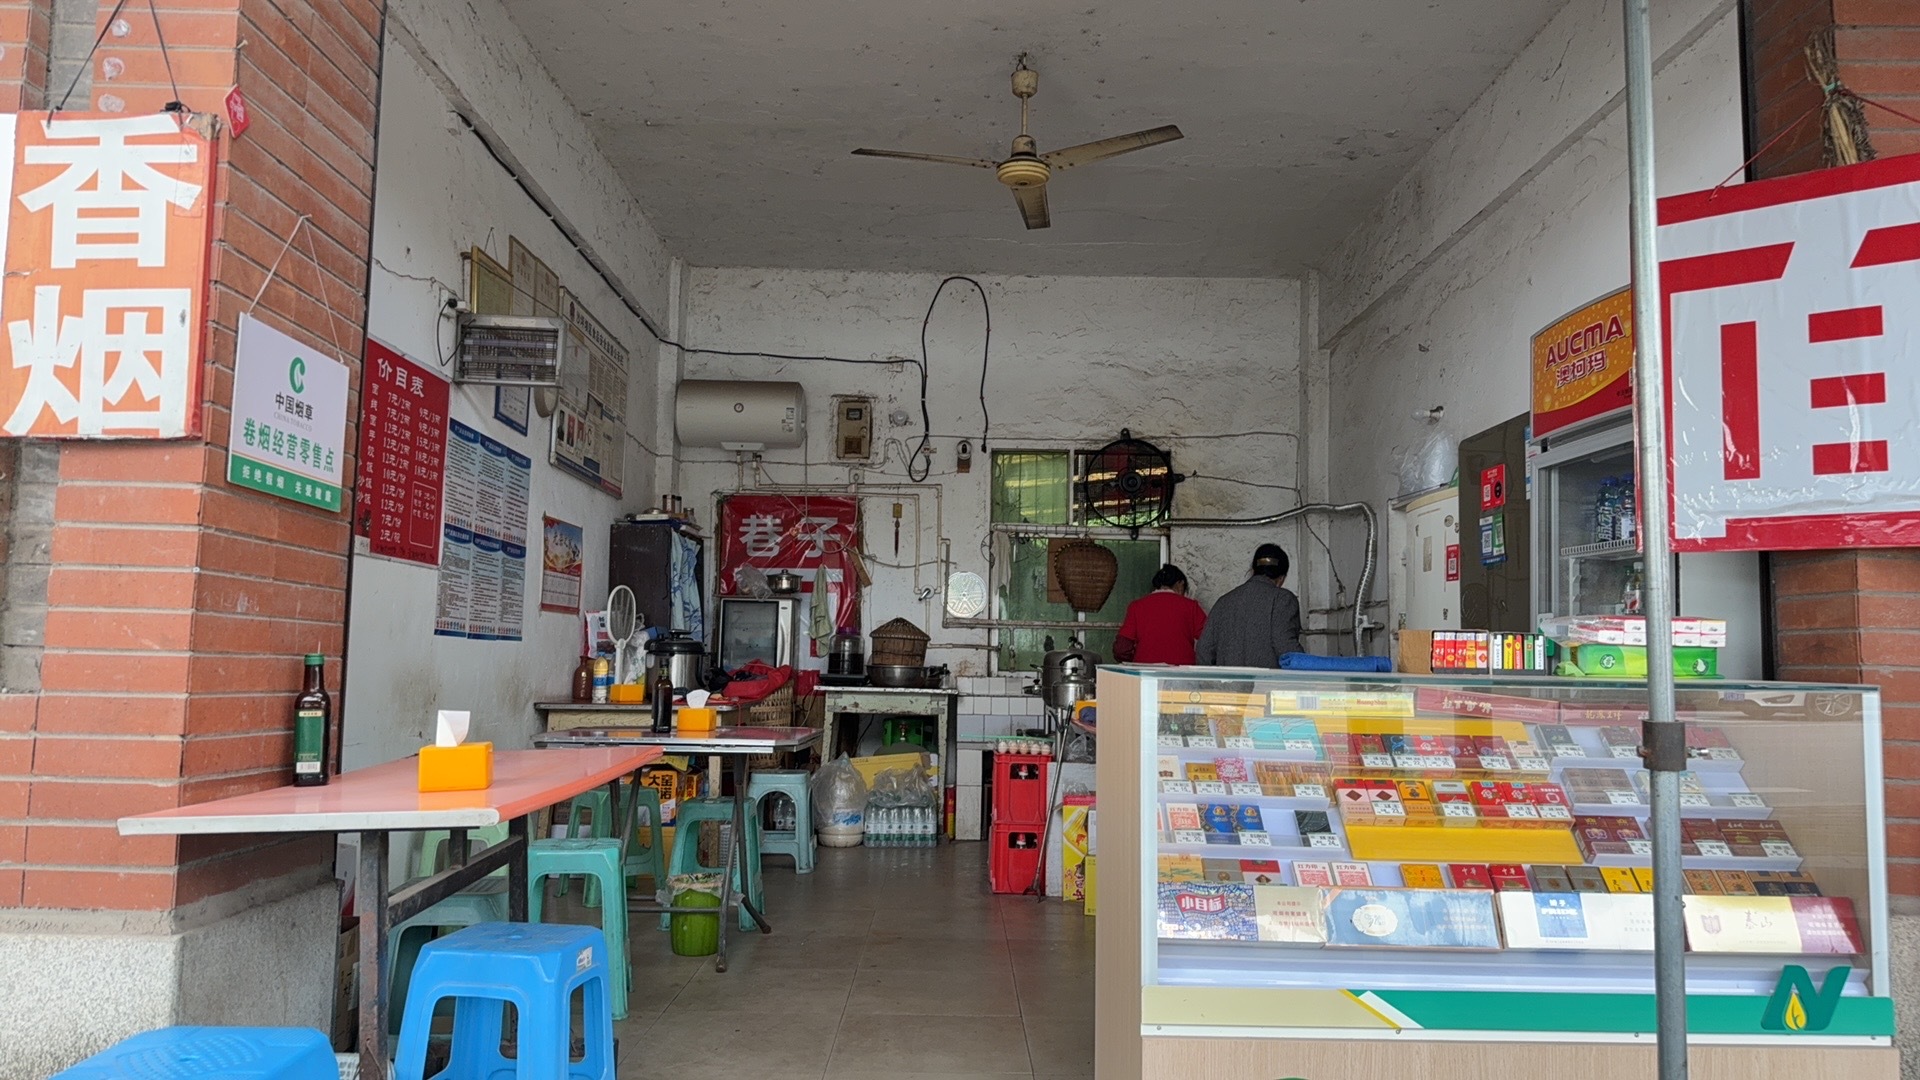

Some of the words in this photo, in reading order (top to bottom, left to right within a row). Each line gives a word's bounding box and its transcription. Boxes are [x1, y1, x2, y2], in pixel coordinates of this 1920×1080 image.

[3, 114, 202, 436] 香烟
[1544, 314, 1625, 371] AUCMA
[377, 358, 425, 398] 价目表
[1556, 349, 1608, 388] 澳柯玛
[275, 391, 314, 421] 中国烟草
[243, 417, 335, 473] 卷烟经营零售点
[242, 464, 285, 489] 拒绝假烟
[739, 514, 841, 557] 巷子
[648, 774, 673, 787] 大窑
[1181, 895, 1222, 912] 小目标
